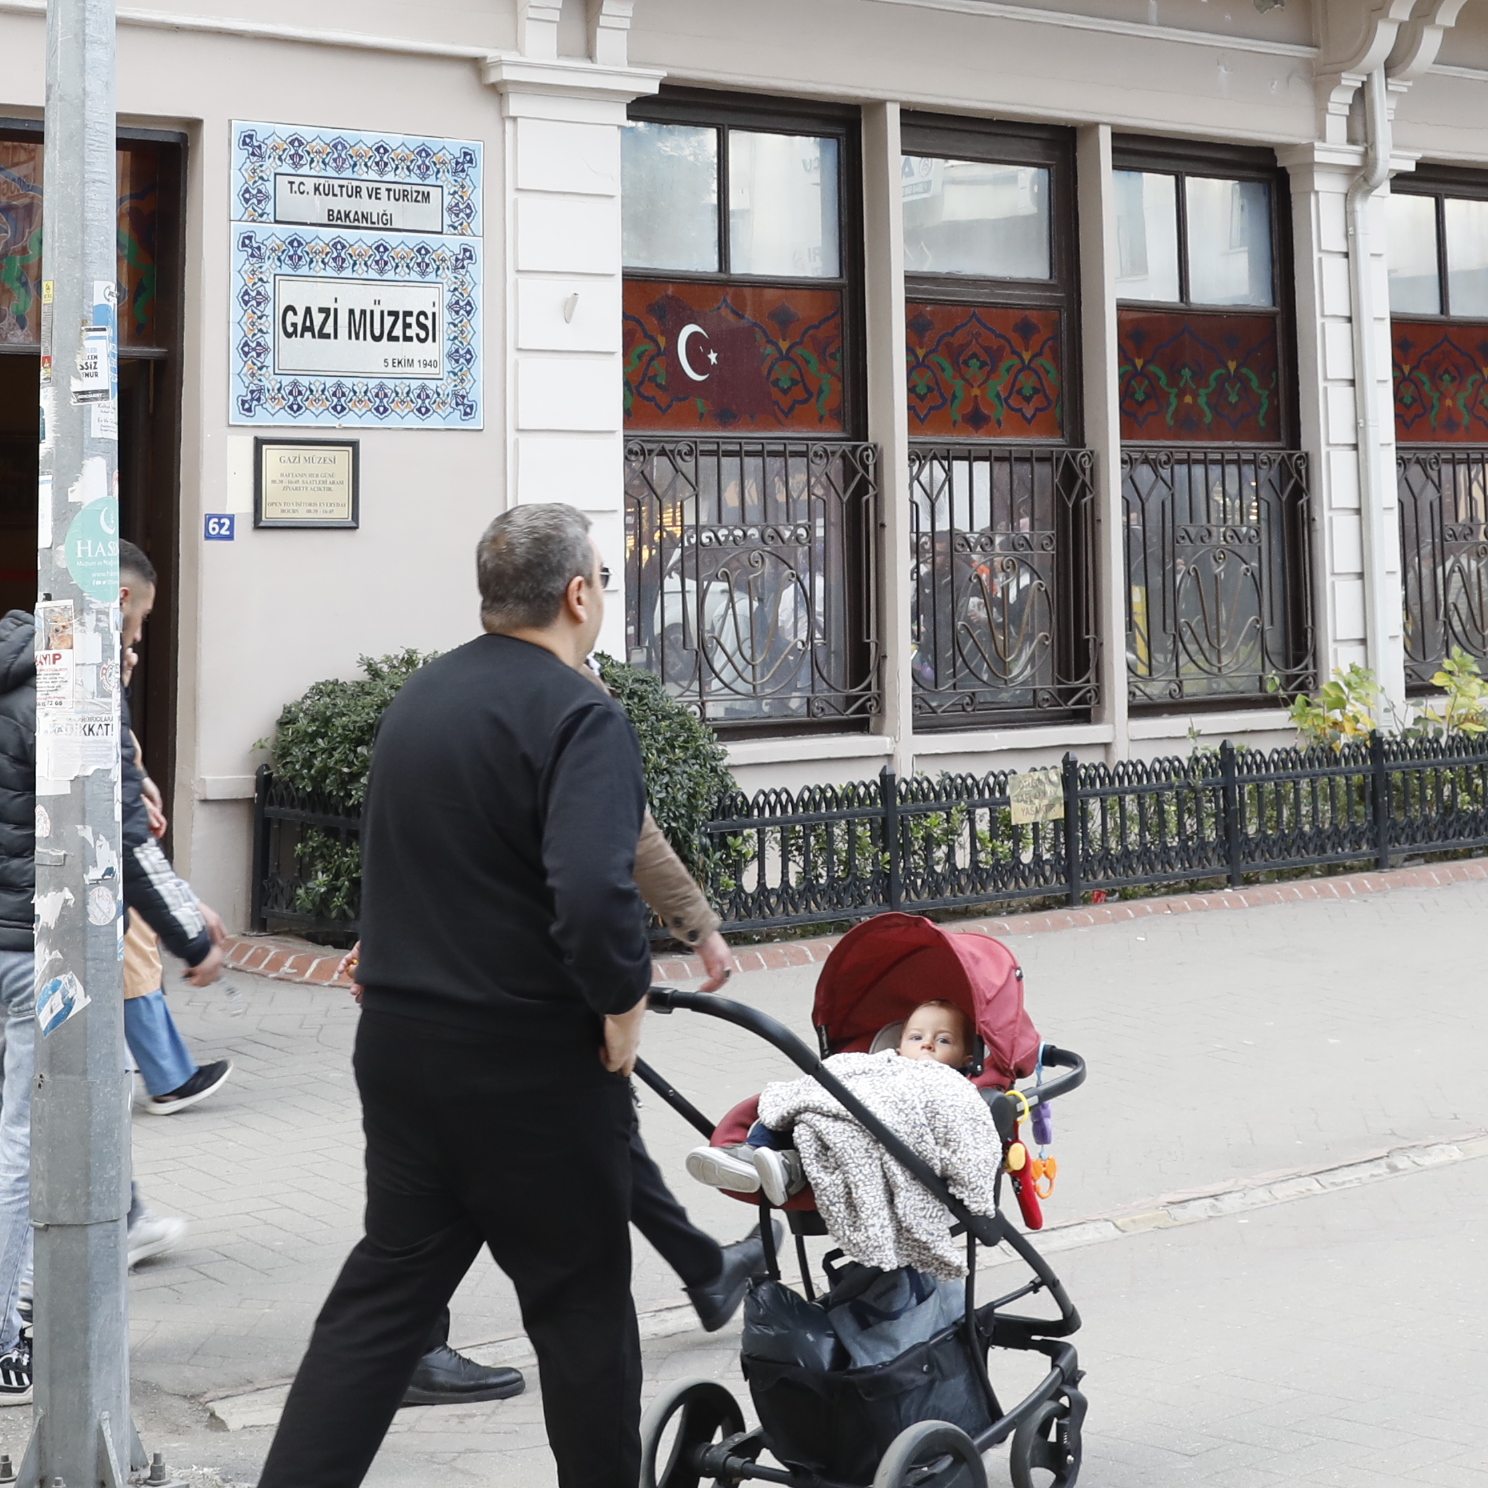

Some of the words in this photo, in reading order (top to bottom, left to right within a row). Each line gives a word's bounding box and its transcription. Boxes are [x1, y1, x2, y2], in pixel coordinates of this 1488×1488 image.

[288, 179, 309, 196] T.C.
[313, 181, 362, 199] KÜLTÜR
[365, 186, 382, 200] VE
[385, 185, 431, 204] TURİZM
[327, 205, 393, 226] BAKANLIĞI
[281, 297, 338, 340] GAZİ
[348, 300, 437, 344] MÜZESİ
[383, 357, 389, 368] 5
[391, 355, 414, 369] EKİM
[417, 358, 438, 369] 1940
[208, 517, 230, 535] 62
